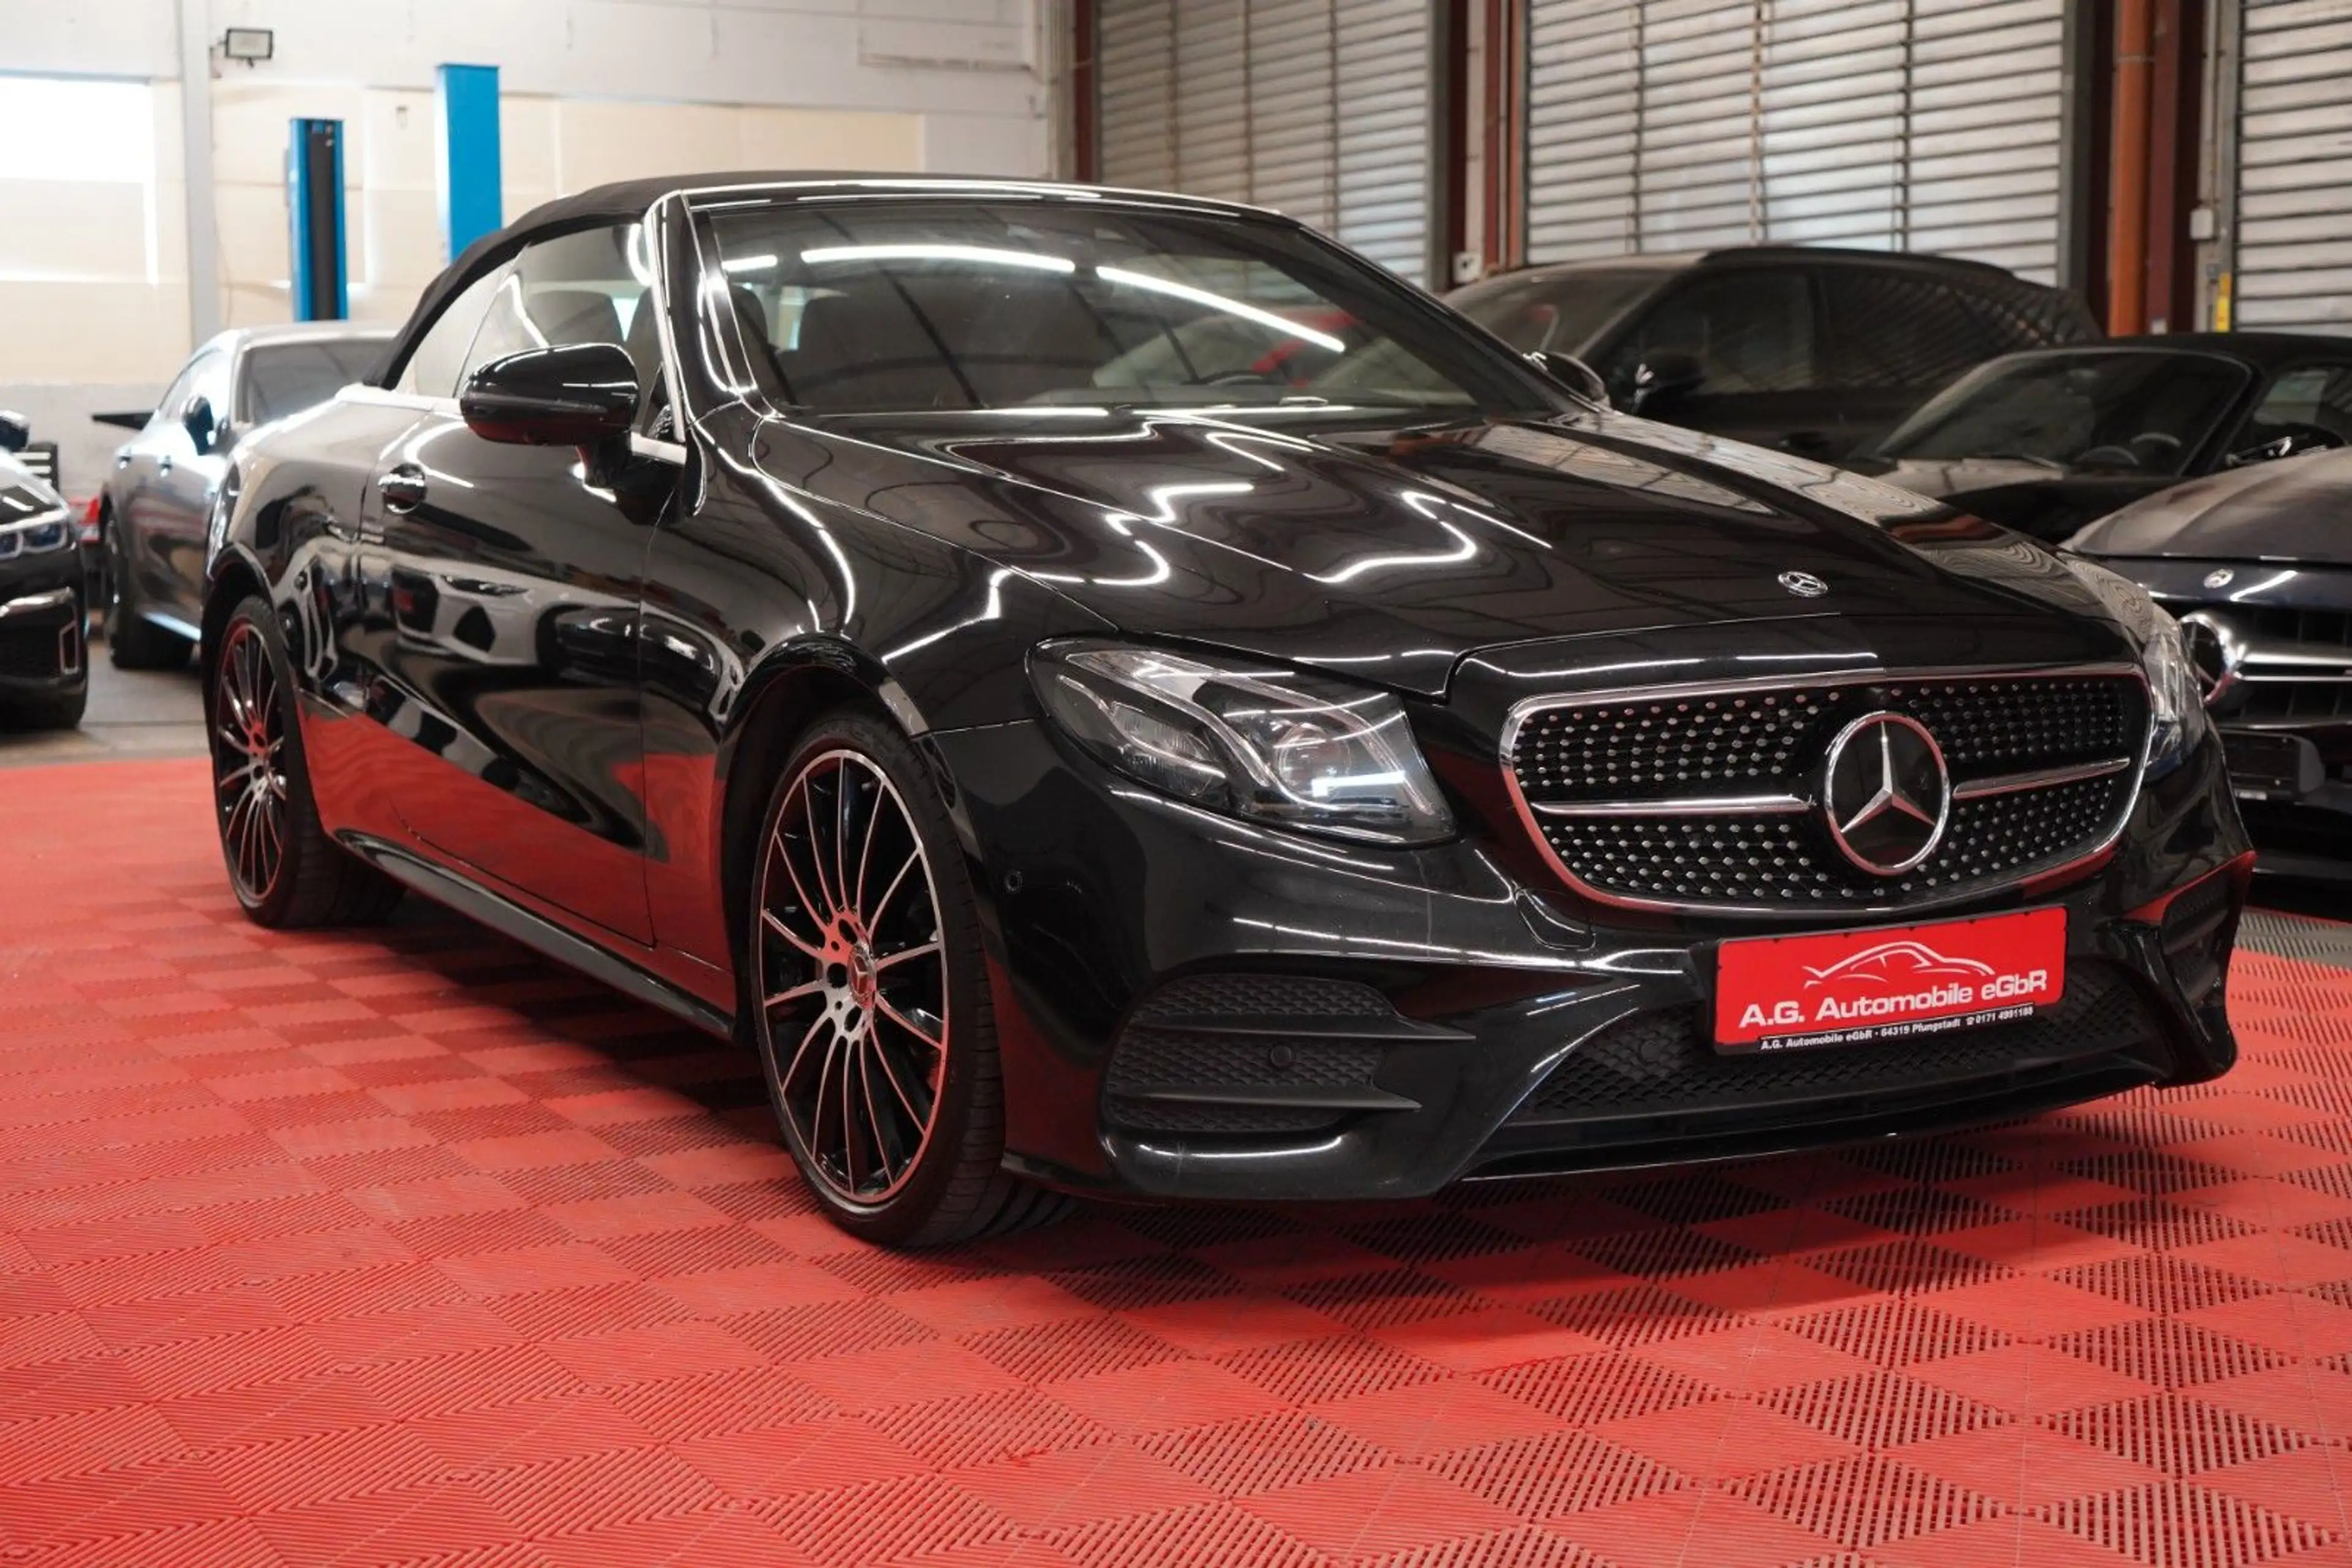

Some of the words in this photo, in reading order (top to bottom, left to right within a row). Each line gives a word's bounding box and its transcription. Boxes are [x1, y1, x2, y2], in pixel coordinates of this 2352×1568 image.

[1738, 1001, 1805, 1028] A.G.
[1815, 982, 1973, 1021] Automobile
[1981, 970, 2047, 1000] eGbR
[1760, 1039, 1783, 1050] A.G.
[1785, 1033, 1844, 1047] Automobile
[1845, 1030, 1872, 1042] eGbR
